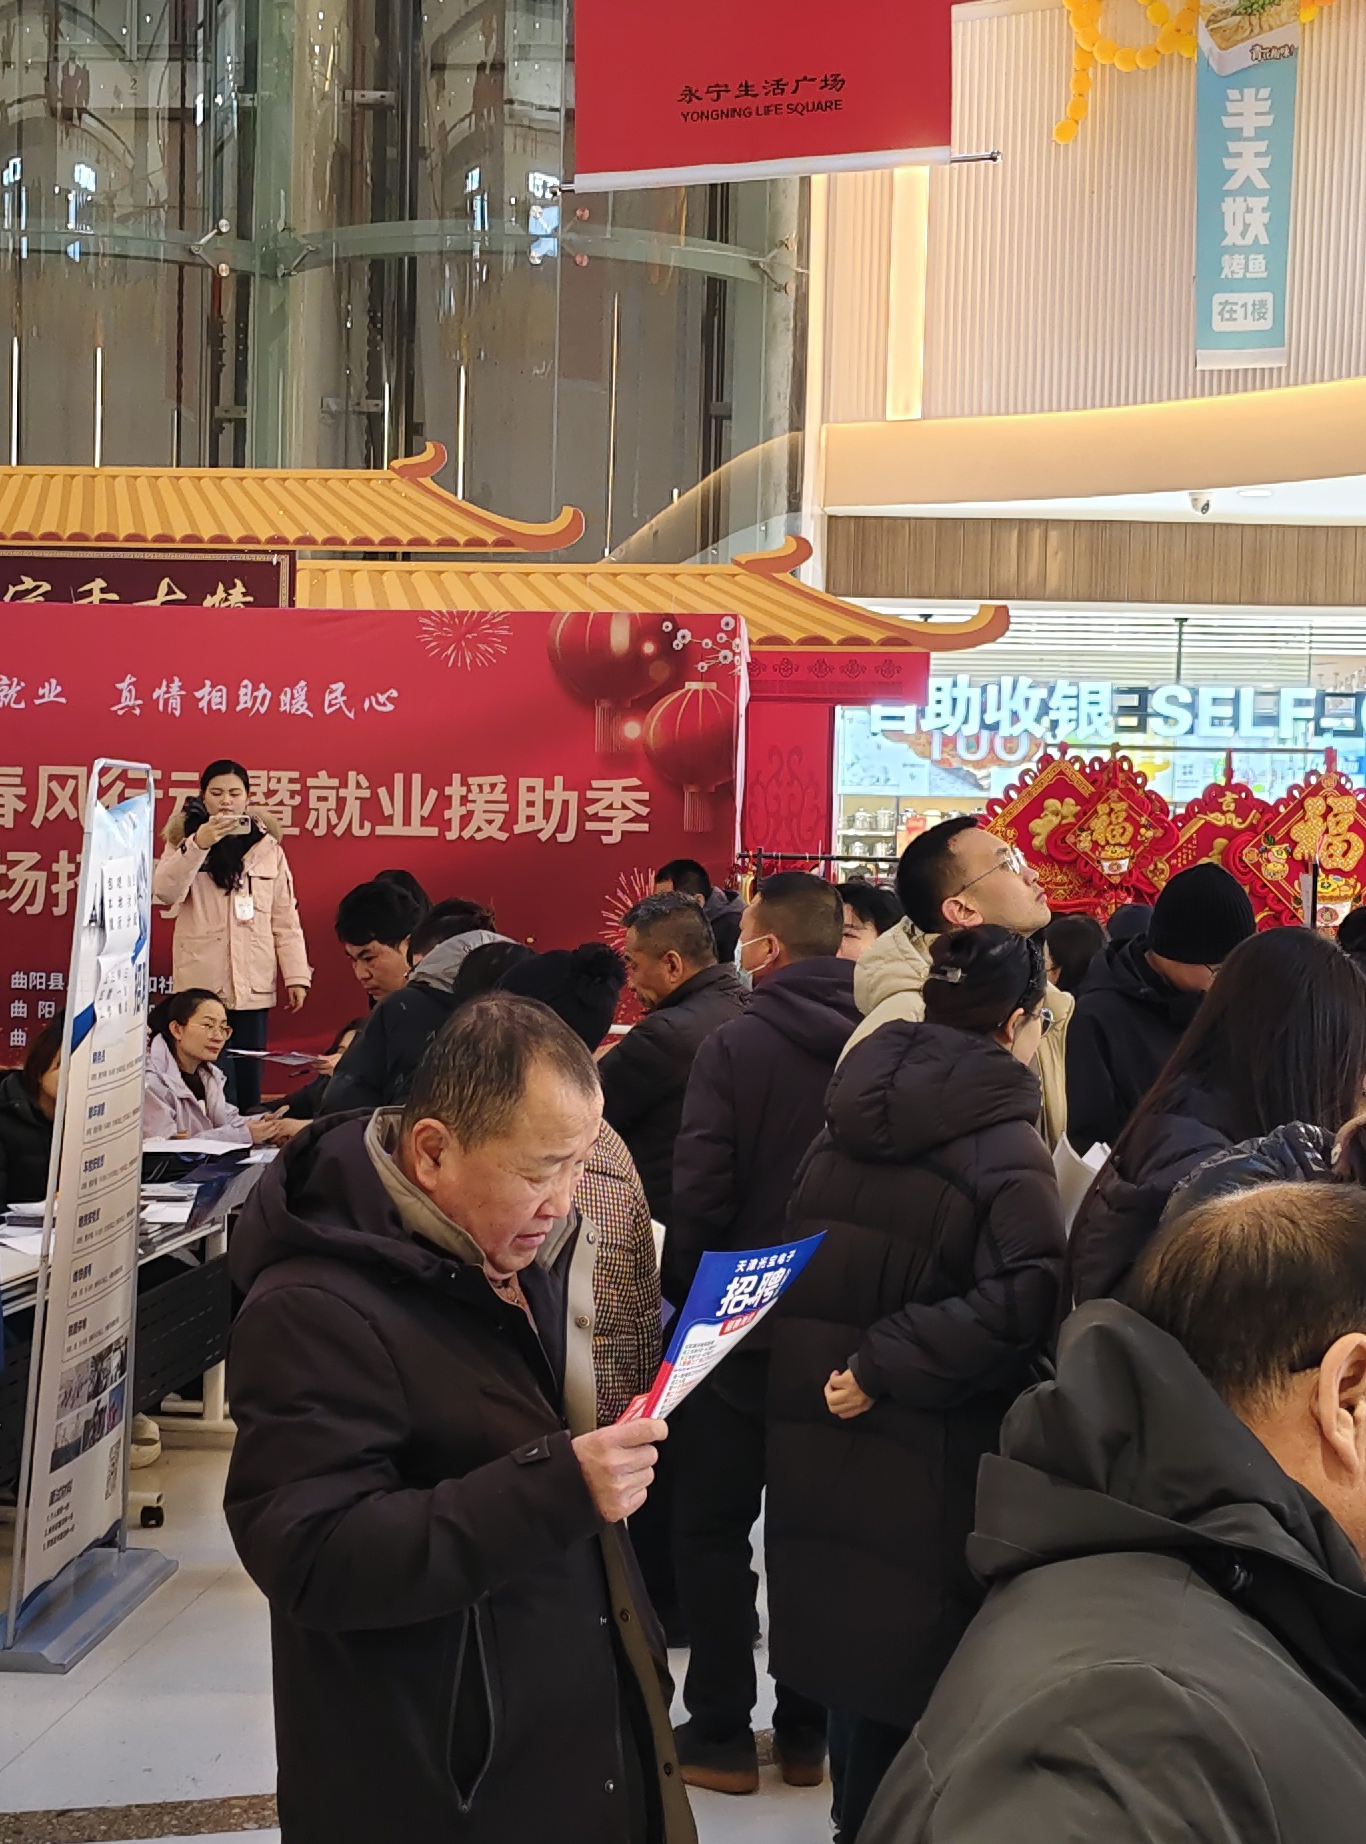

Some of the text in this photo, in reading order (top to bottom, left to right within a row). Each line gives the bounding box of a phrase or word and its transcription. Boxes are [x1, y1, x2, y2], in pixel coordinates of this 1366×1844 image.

[677, 73, 846, 104] 永宁生活广场
[680, 99, 843, 123] YONGNING LIFE SQUARE
[1221, 87, 1274, 247] 半天妖
[1220, 253, 1268, 280] 烤鱼
[1218, 299, 1269, 323] 在1楼
[109, 676, 399, 720] 真情相助暖民心
[1290, 795, 1365, 872] 福
[715, 1268, 792, 1317] 招聘
